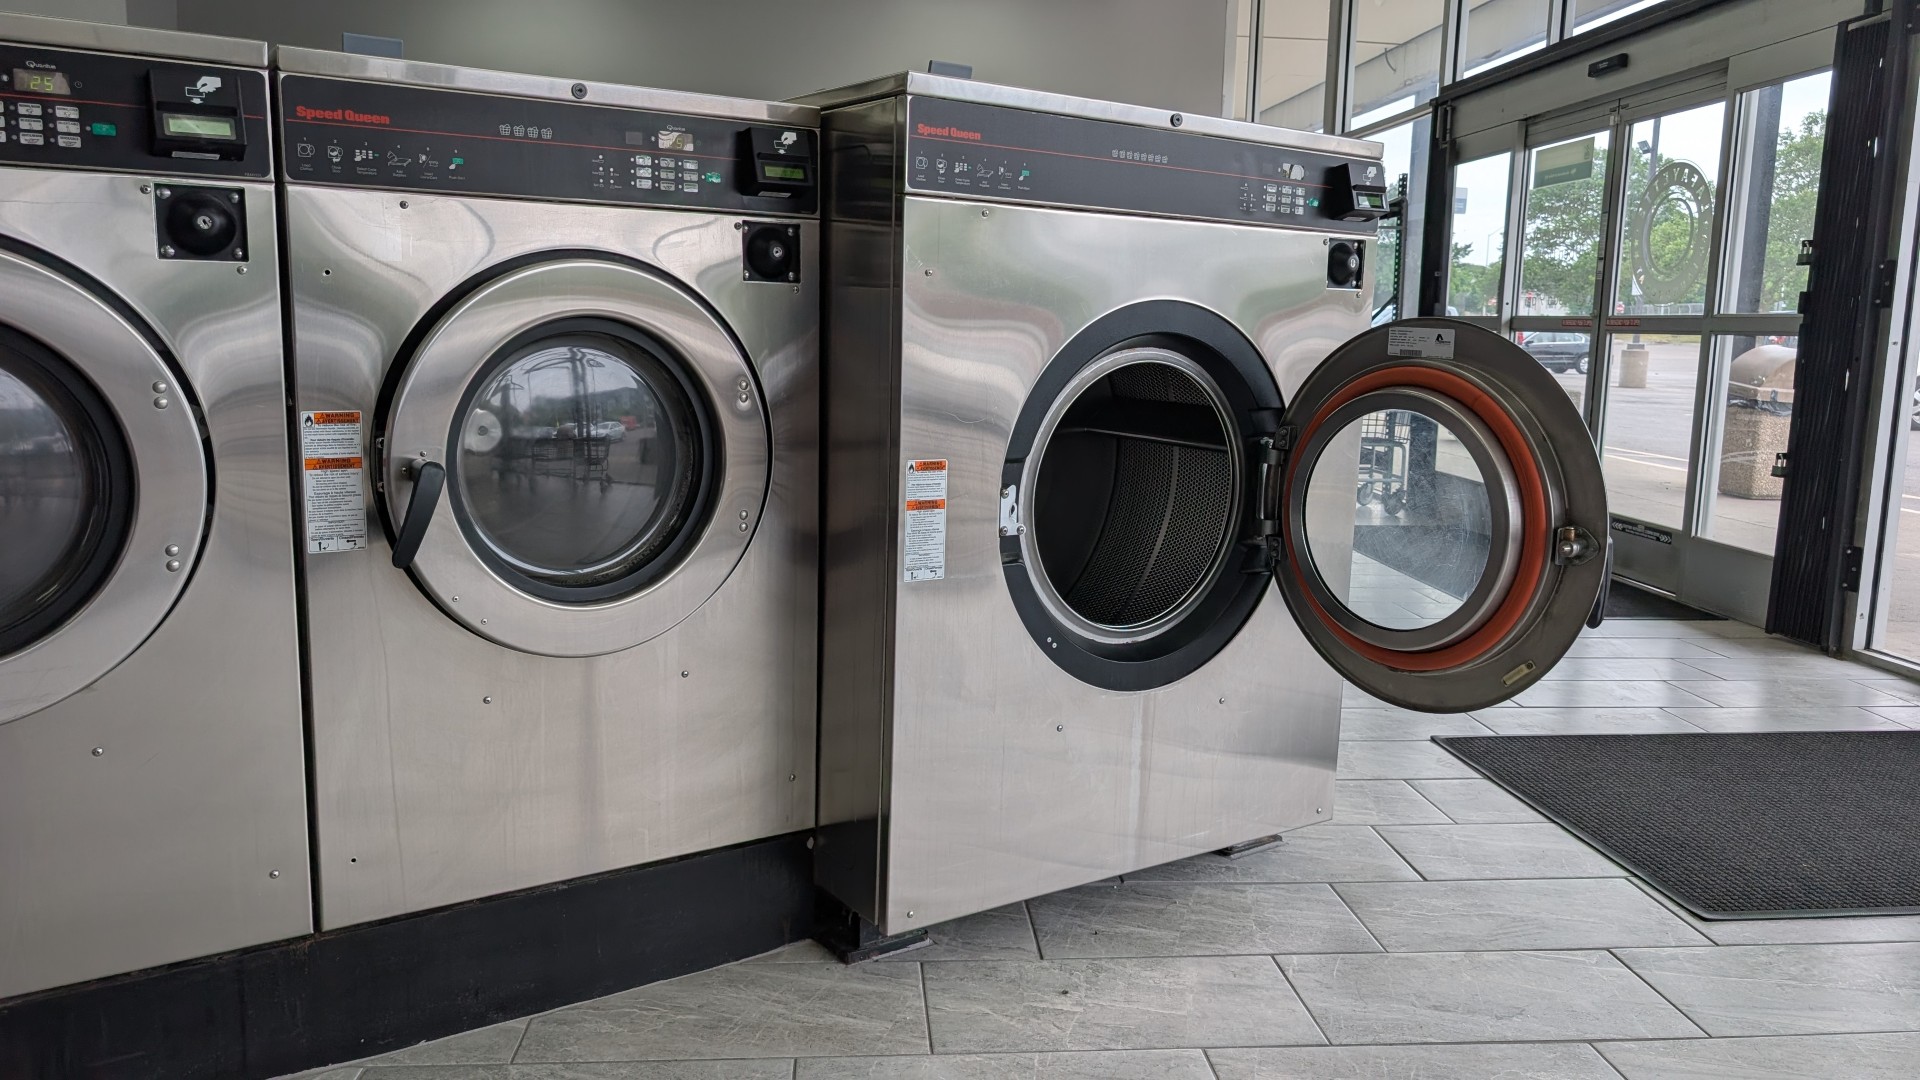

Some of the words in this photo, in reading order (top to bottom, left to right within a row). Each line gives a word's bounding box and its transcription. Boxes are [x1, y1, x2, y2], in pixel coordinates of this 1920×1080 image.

[26, 61, 56, 70] Quantum
[30, 76, 53, 91] 25
[296, 105, 342, 120] Speed
[345, 110, 390, 125] Queen
[917, 123, 949, 136] Speed
[951, 127, 981, 140] Queen
